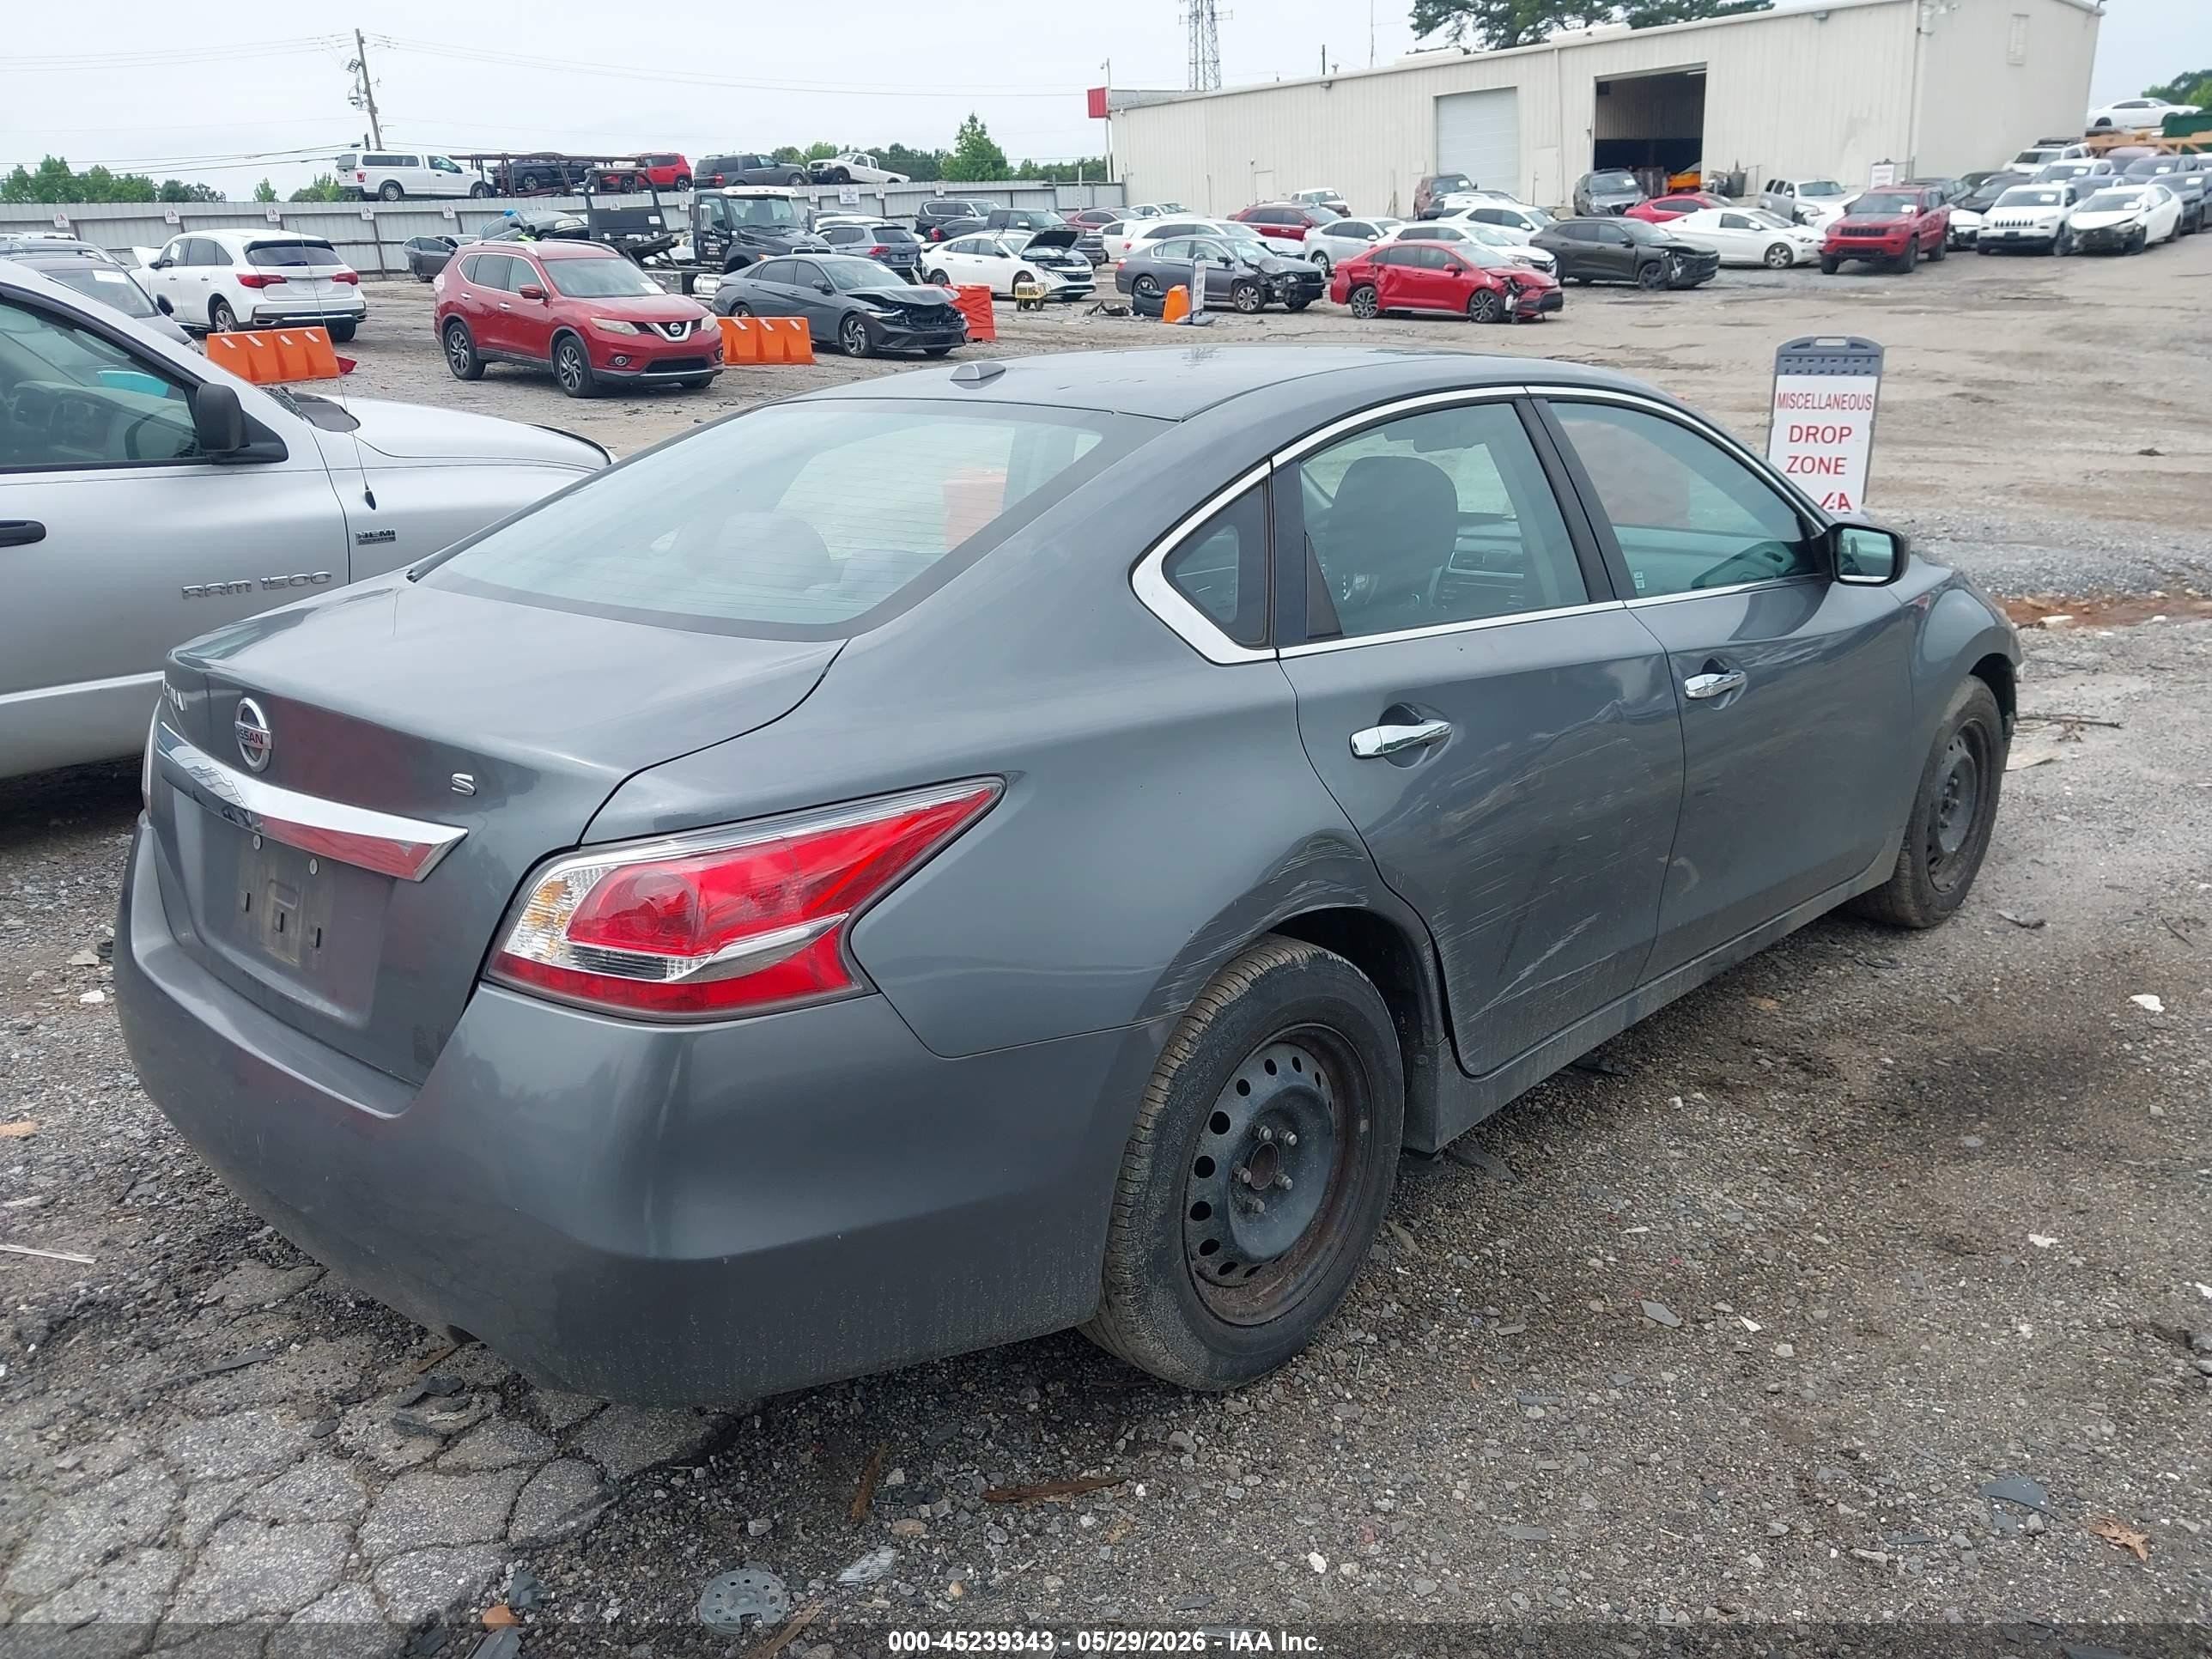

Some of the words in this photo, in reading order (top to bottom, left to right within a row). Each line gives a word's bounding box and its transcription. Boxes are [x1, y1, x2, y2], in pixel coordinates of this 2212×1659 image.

[1777, 392, 1873, 410] MISCELLANEOUS
[1789, 425, 1852, 444] DROP
[1786, 456, 1847, 475] ZONE
[181, 580, 252, 599] RAM
[259, 571, 332, 592] 1500
[451, 773, 476, 796] S
